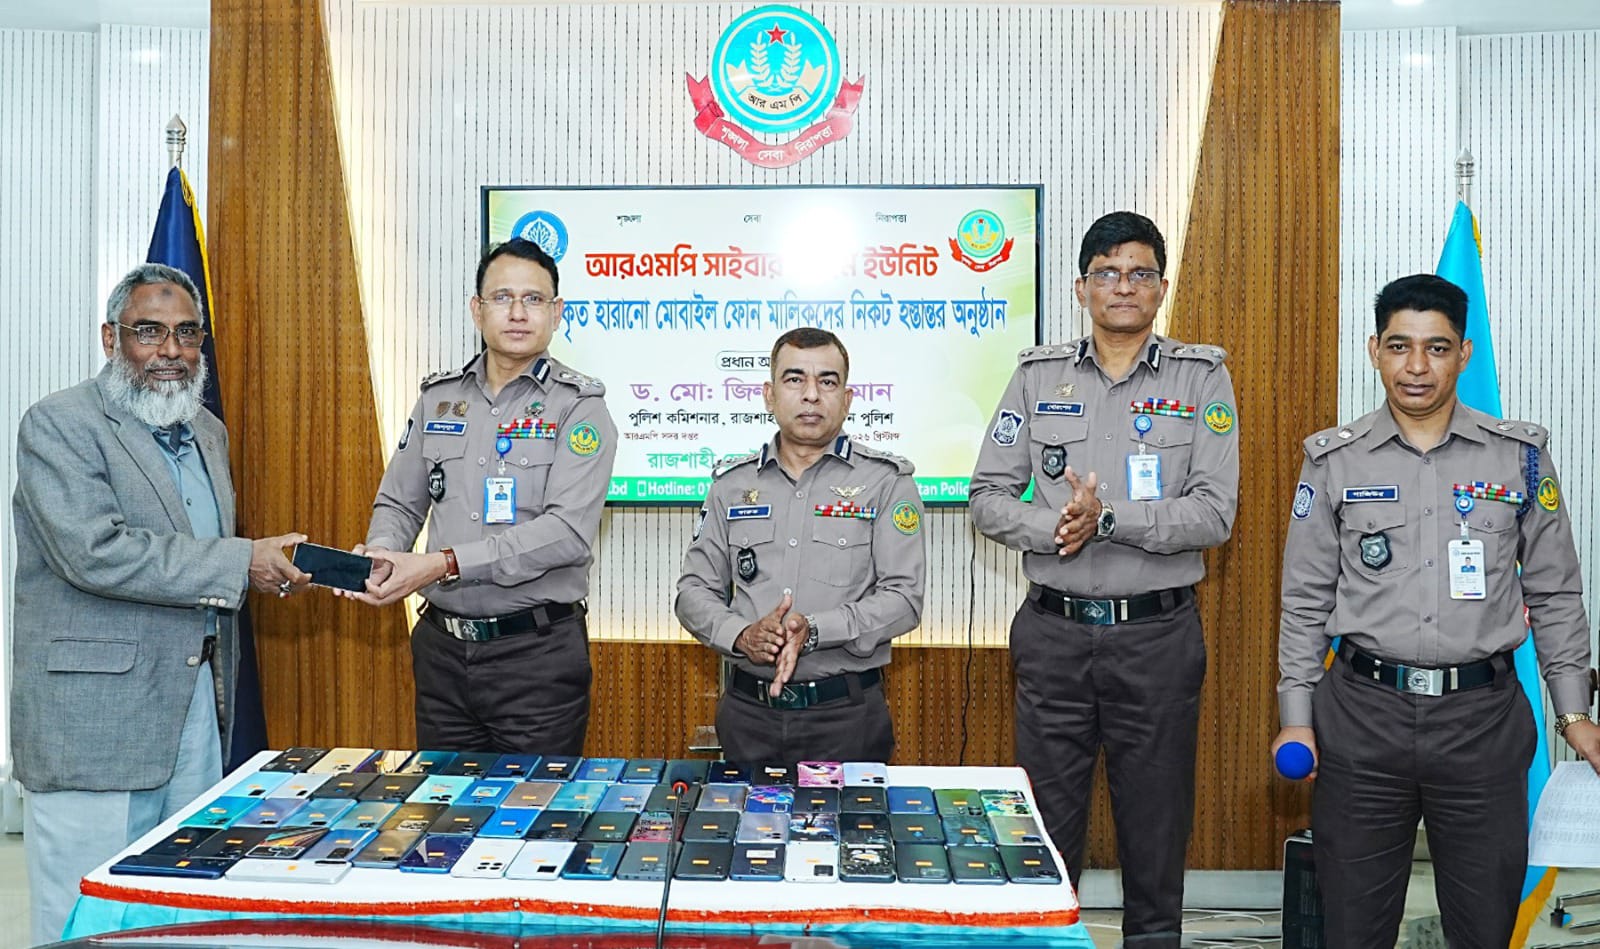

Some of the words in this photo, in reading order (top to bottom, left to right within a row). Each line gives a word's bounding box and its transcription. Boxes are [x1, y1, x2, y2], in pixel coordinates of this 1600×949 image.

[748, 93, 766, 109] আর
[770, 100, 787, 110] এম
[789, 94, 803, 107] পি
[758, 150, 785, 161] সেবা
[585, 243, 698, 280] আরএমপি
[703, 246, 782, 280] সাইবার
[863, 243, 939, 279] ইউনিট
[593, 299, 650, 330] হারানো
[655, 289, 718, 330] মোবাইল
[723, 299, 762, 330] ফোন
[767, 289, 845, 329] মালিকদের
[850, 288, 893, 329] নিকট
[898, 299, 947, 330] হস্তান্তর
[951, 286, 1008, 338] অনুষ্ঠান
[721, 356, 754, 368] প্রধান
[630, 383, 659, 401] ড.
[629, 409, 661, 427] পুলিশ
[730, 413, 776, 424] রাজশাহ
[860, 409, 894, 427] পুলিশ
[646, 447, 716, 469] রাজশাহী
[648, 481, 696, 495] Hotline:
[941, 482, 970, 495] Polic
